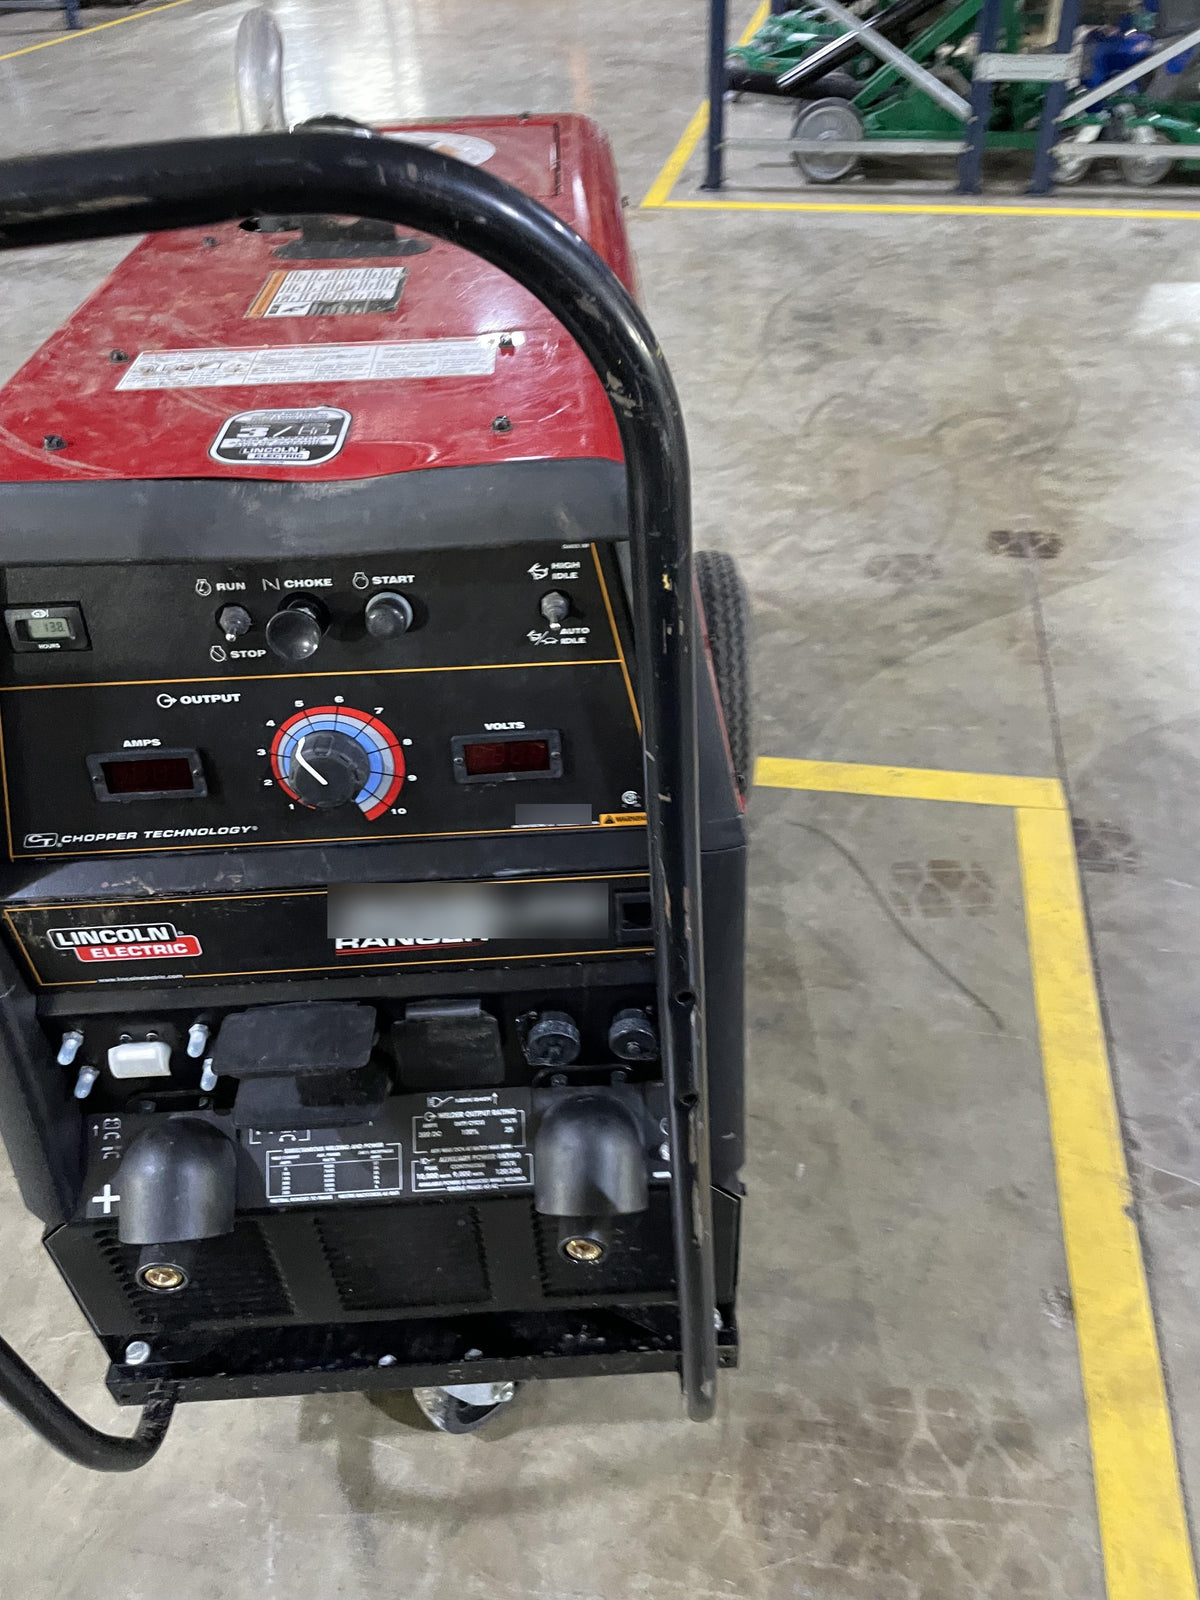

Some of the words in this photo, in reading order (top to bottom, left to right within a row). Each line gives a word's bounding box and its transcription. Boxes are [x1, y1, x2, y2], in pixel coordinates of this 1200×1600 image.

[551, 562, 581, 570] HIGH
[372, 575, 415, 586] START
[551, 572, 579, 580] IDLE
[216, 582, 247, 592] RUN
[283, 578, 333, 590] CHOKE
[560, 627, 591, 635] AUTO
[230, 649, 267, 659] STOP
[180, 693, 241, 705] OUTPUT
[334, 695, 345, 704] 6
[294, 700, 305, 708] 5
[374, 707, 384, 715] 7
[265, 720, 276, 728] 4
[484, 721, 526, 731] VOLTS
[123, 738, 162, 748] AMPS
[402, 738, 413, 746] 8
[256, 748, 267, 756] 3
[407, 774, 418, 782] 9
[263, 779, 273, 787] 2
[60, 831, 138, 844] CHOPPER
[55, 926, 172, 947] LINCOLN
[89, 943, 188, 959] ELECTRIC
